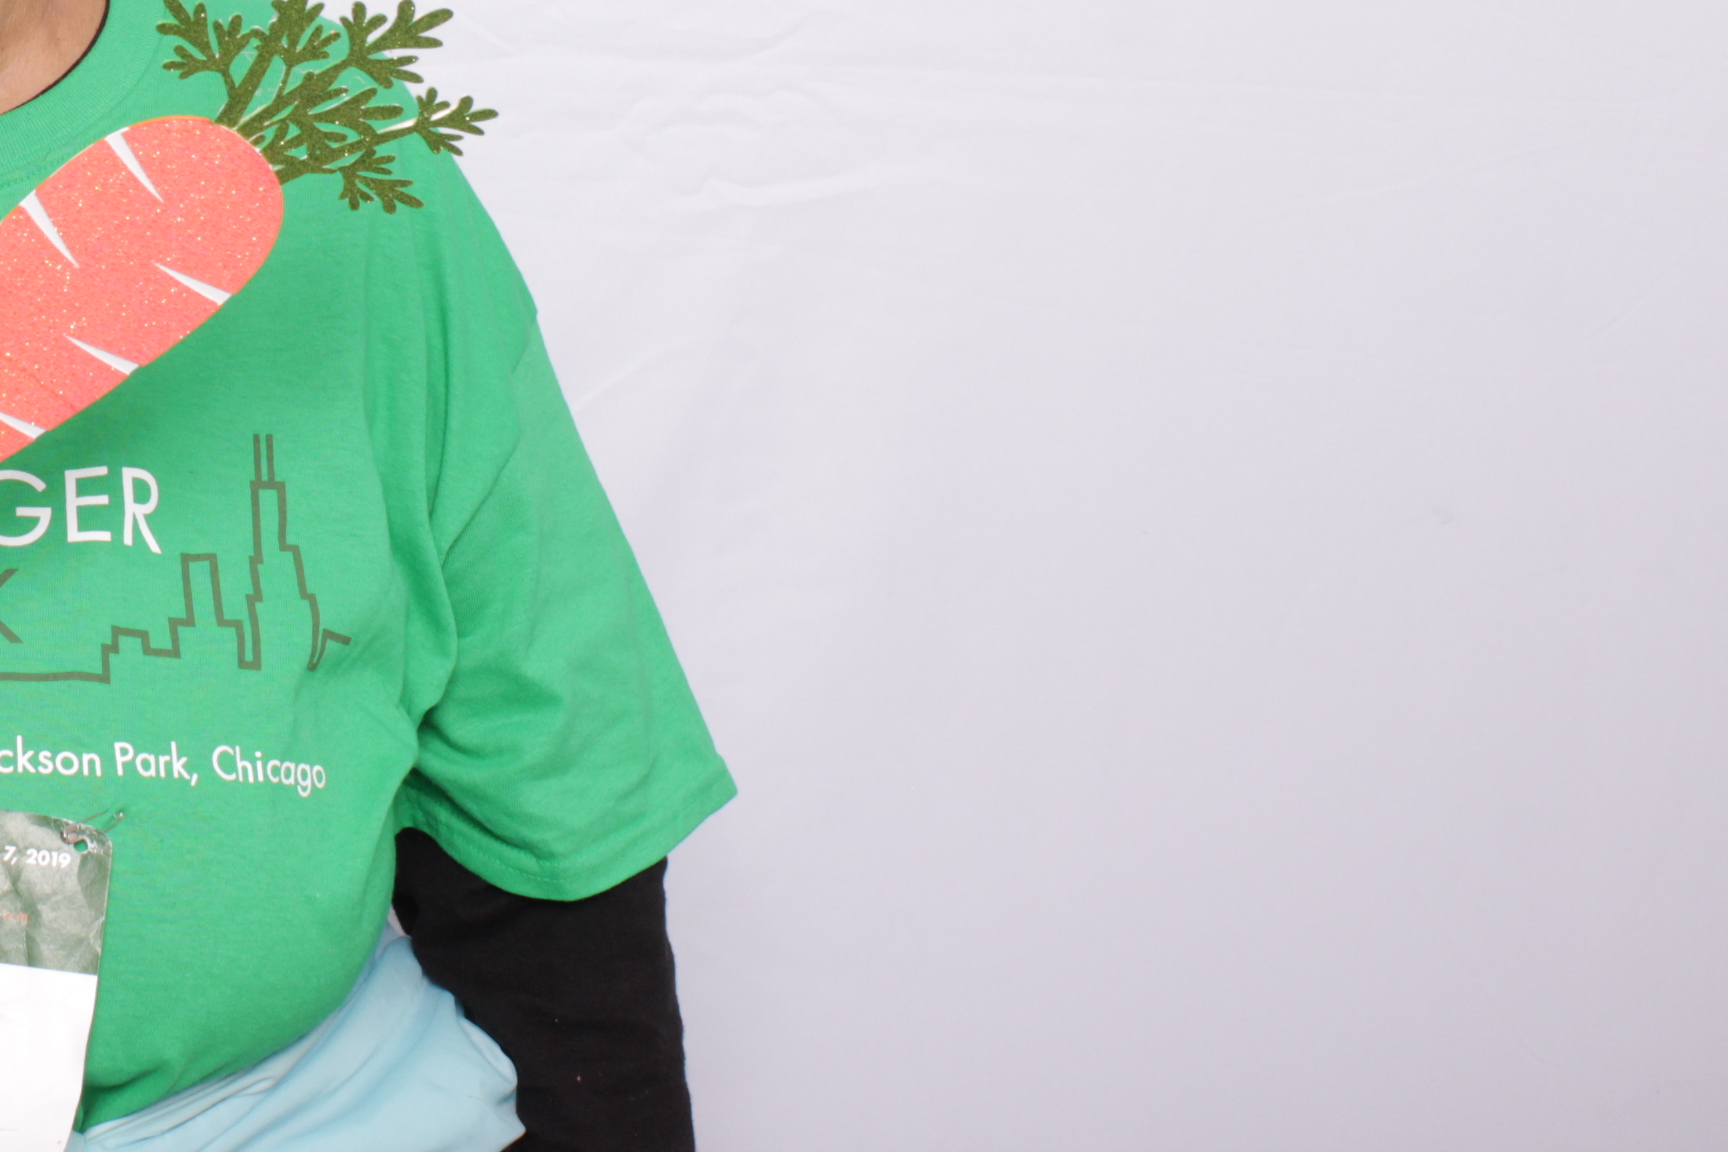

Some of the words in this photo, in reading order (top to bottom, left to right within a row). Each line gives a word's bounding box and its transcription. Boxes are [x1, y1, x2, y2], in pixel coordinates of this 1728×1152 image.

[114, 741, 199, 786] Park,
[212, 746, 326, 798] Chicago
[4, 846, 18, 865] 7,
[25, 848, 72, 869] 2019
